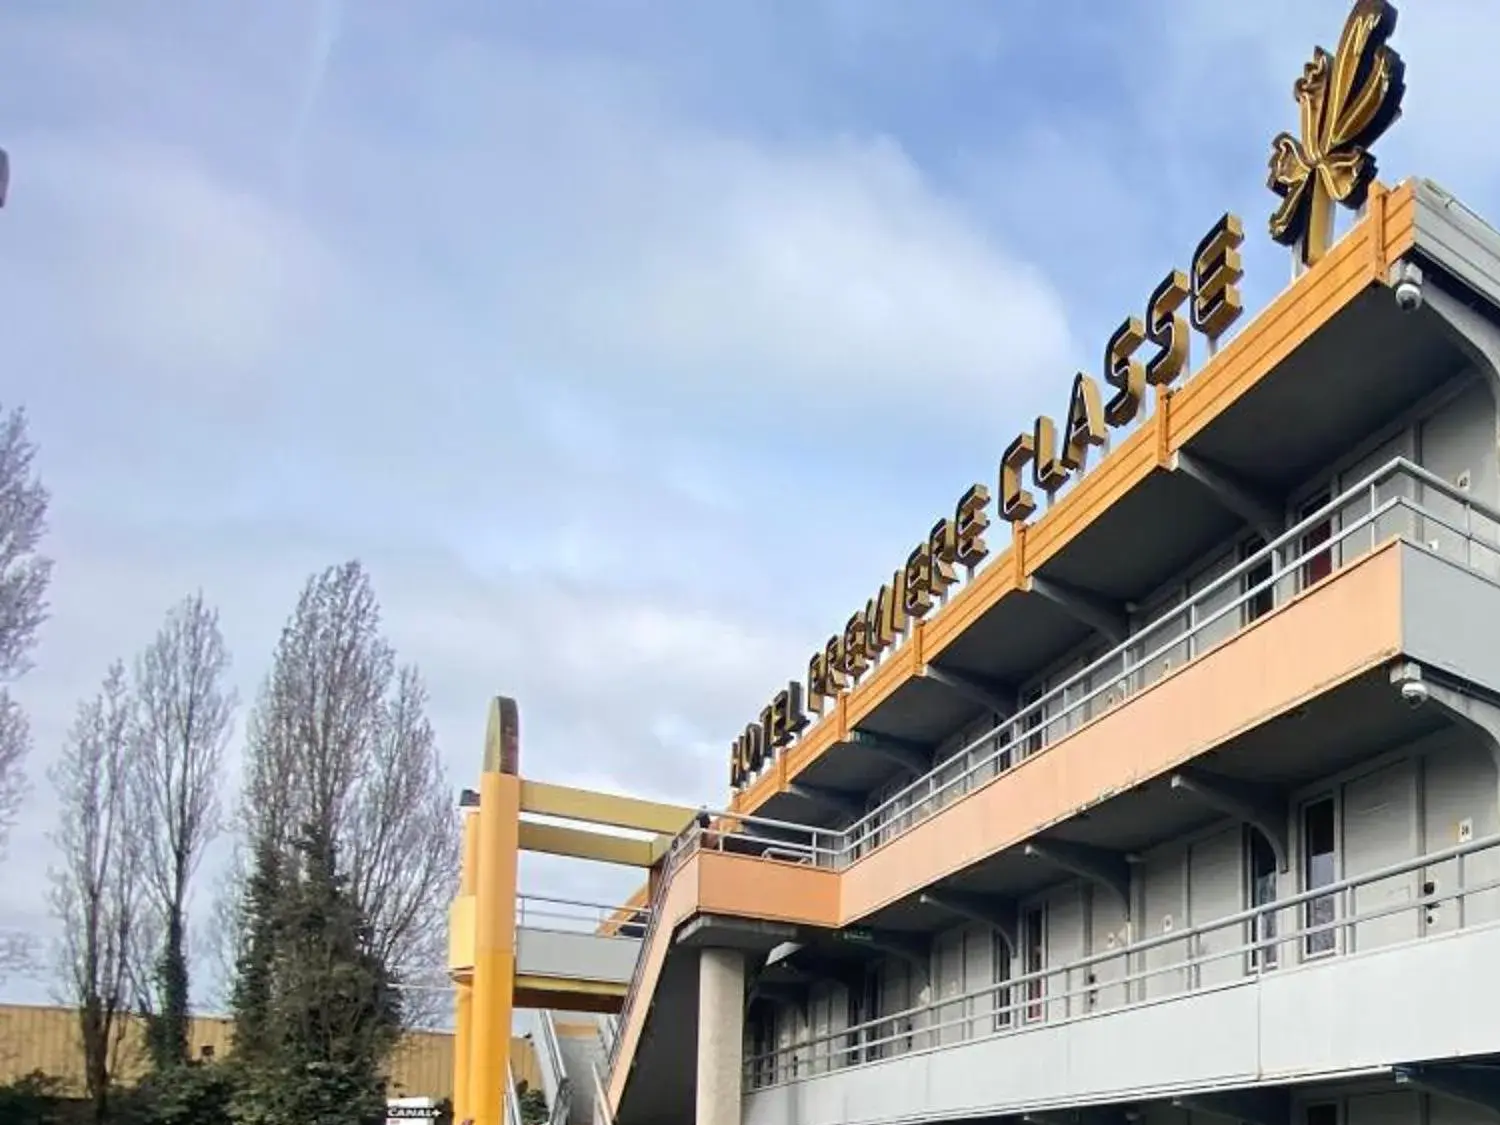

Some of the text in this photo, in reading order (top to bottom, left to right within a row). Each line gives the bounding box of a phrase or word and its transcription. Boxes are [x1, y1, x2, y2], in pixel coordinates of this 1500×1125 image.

[730, 212, 1244, 787] HOTEL PREMIERE CLASSE
